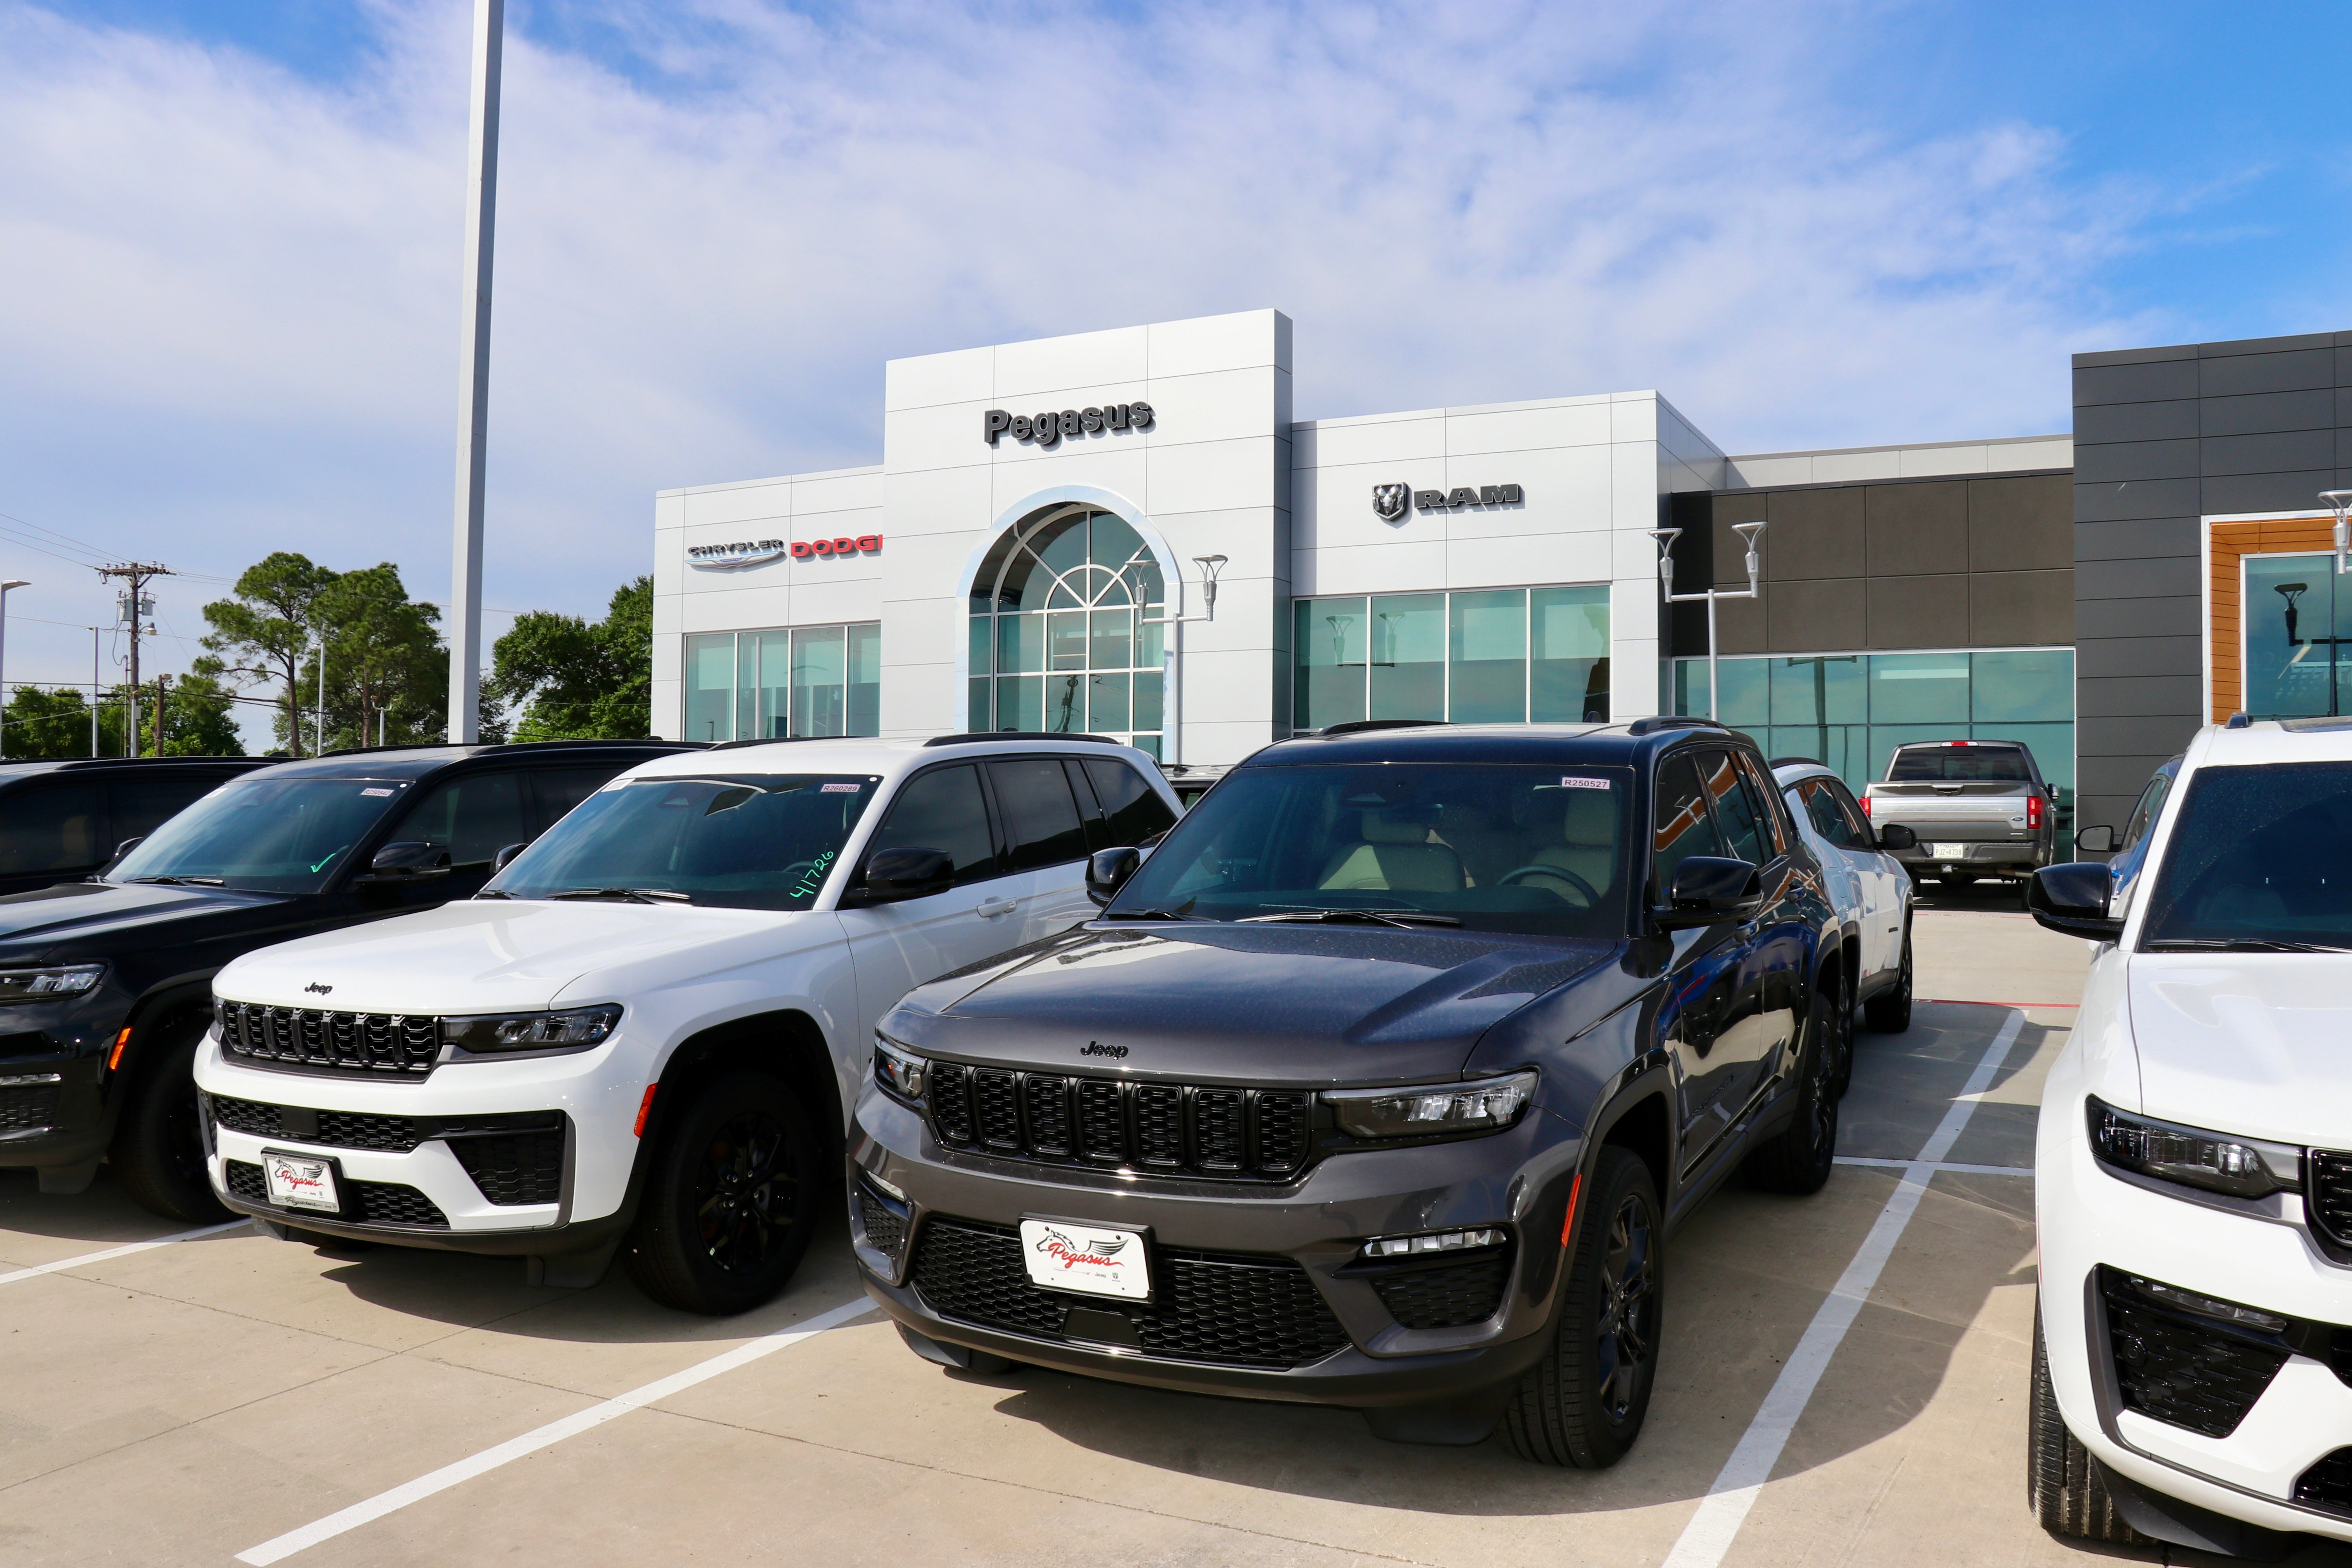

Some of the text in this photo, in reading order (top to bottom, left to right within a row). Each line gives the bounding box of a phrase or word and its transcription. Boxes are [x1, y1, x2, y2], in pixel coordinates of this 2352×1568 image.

[984, 401, 1150, 445] Pegasus
[1414, 483, 1519, 508] RAM
[688, 539, 783, 554] CHRYSLER
[1565, 780, 1607, 788] R250527
[305, 982, 333, 995] Jeep
[1080, 1041, 1128, 1061] Jeep
[281, 1170, 325, 1190] Pegasus
[285, 1197, 322, 1206] Pegasus
[1048, 1243, 1125, 1269] Pegasus
